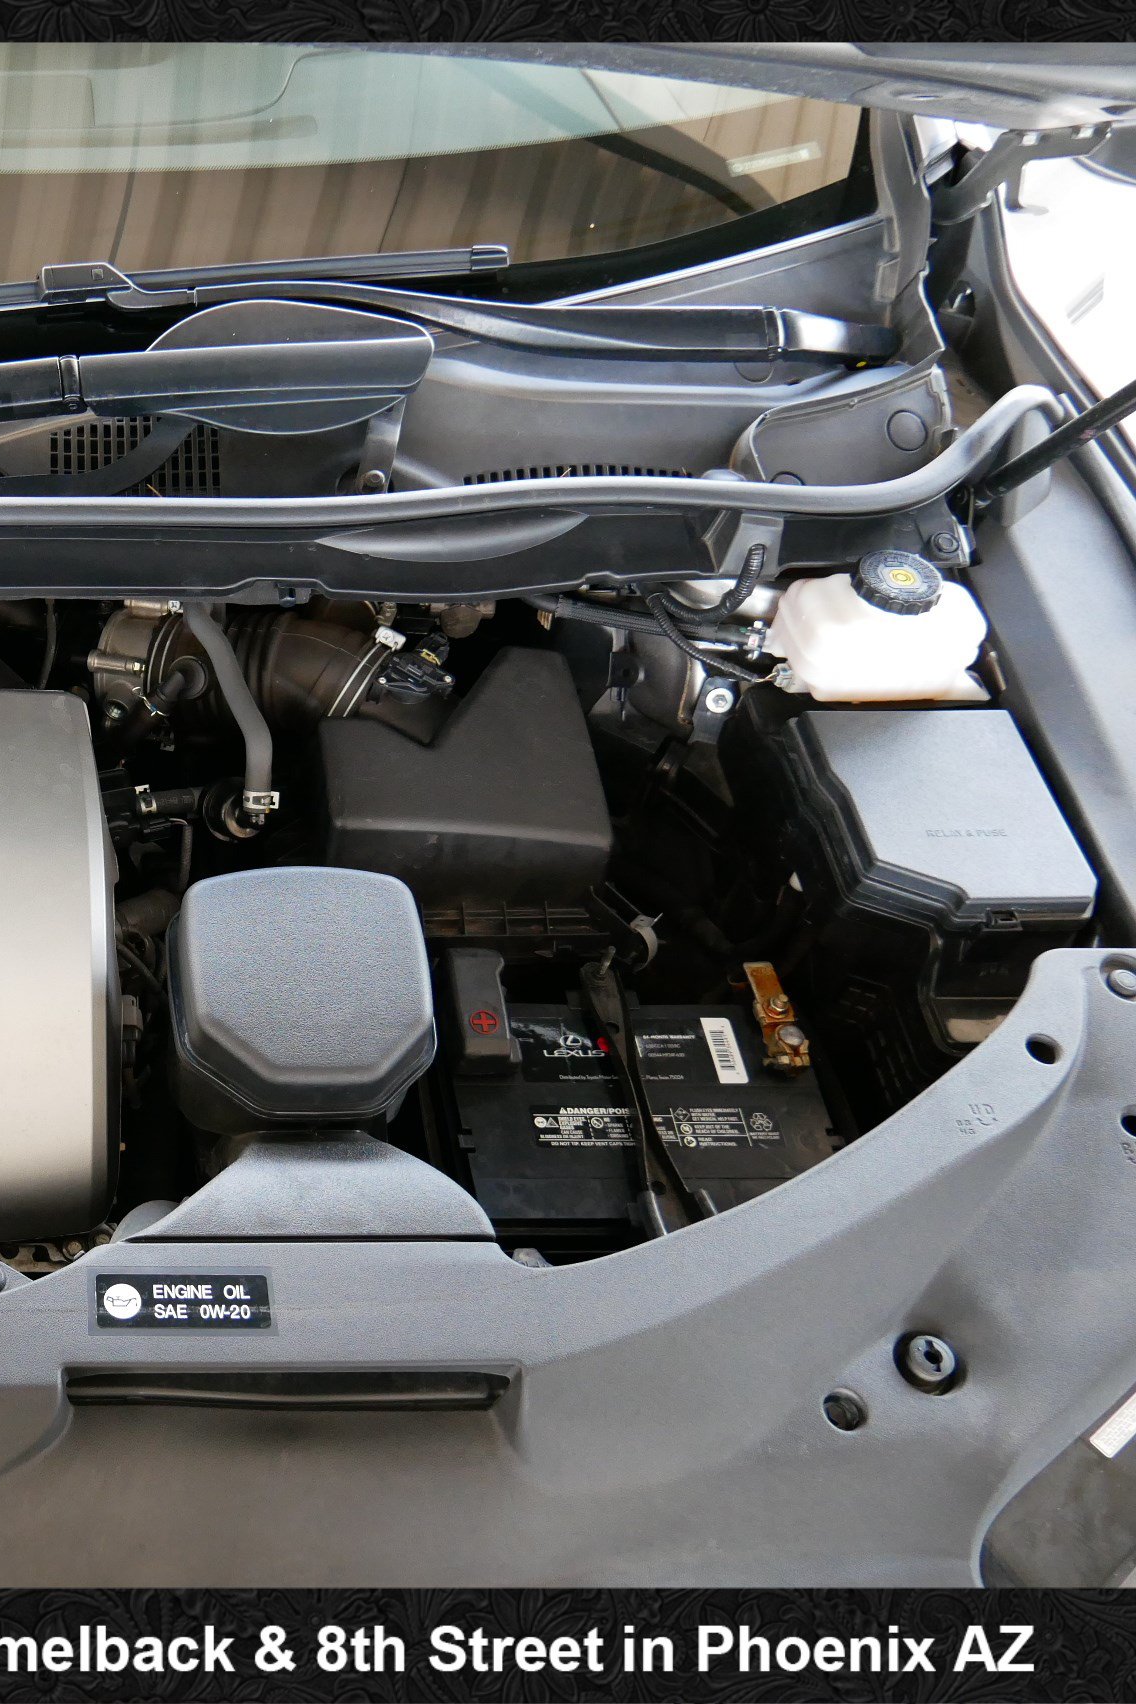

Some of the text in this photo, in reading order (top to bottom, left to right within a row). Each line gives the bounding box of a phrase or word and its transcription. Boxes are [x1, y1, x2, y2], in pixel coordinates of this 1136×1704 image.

[925, 829, 1007, 837] RELAY & FUSE
[543, 1049, 606, 1057] LEXUS
[152, 1284, 251, 1300] ENGINE OIL
[154, 1304, 251, 1319] SAE 0W-20
